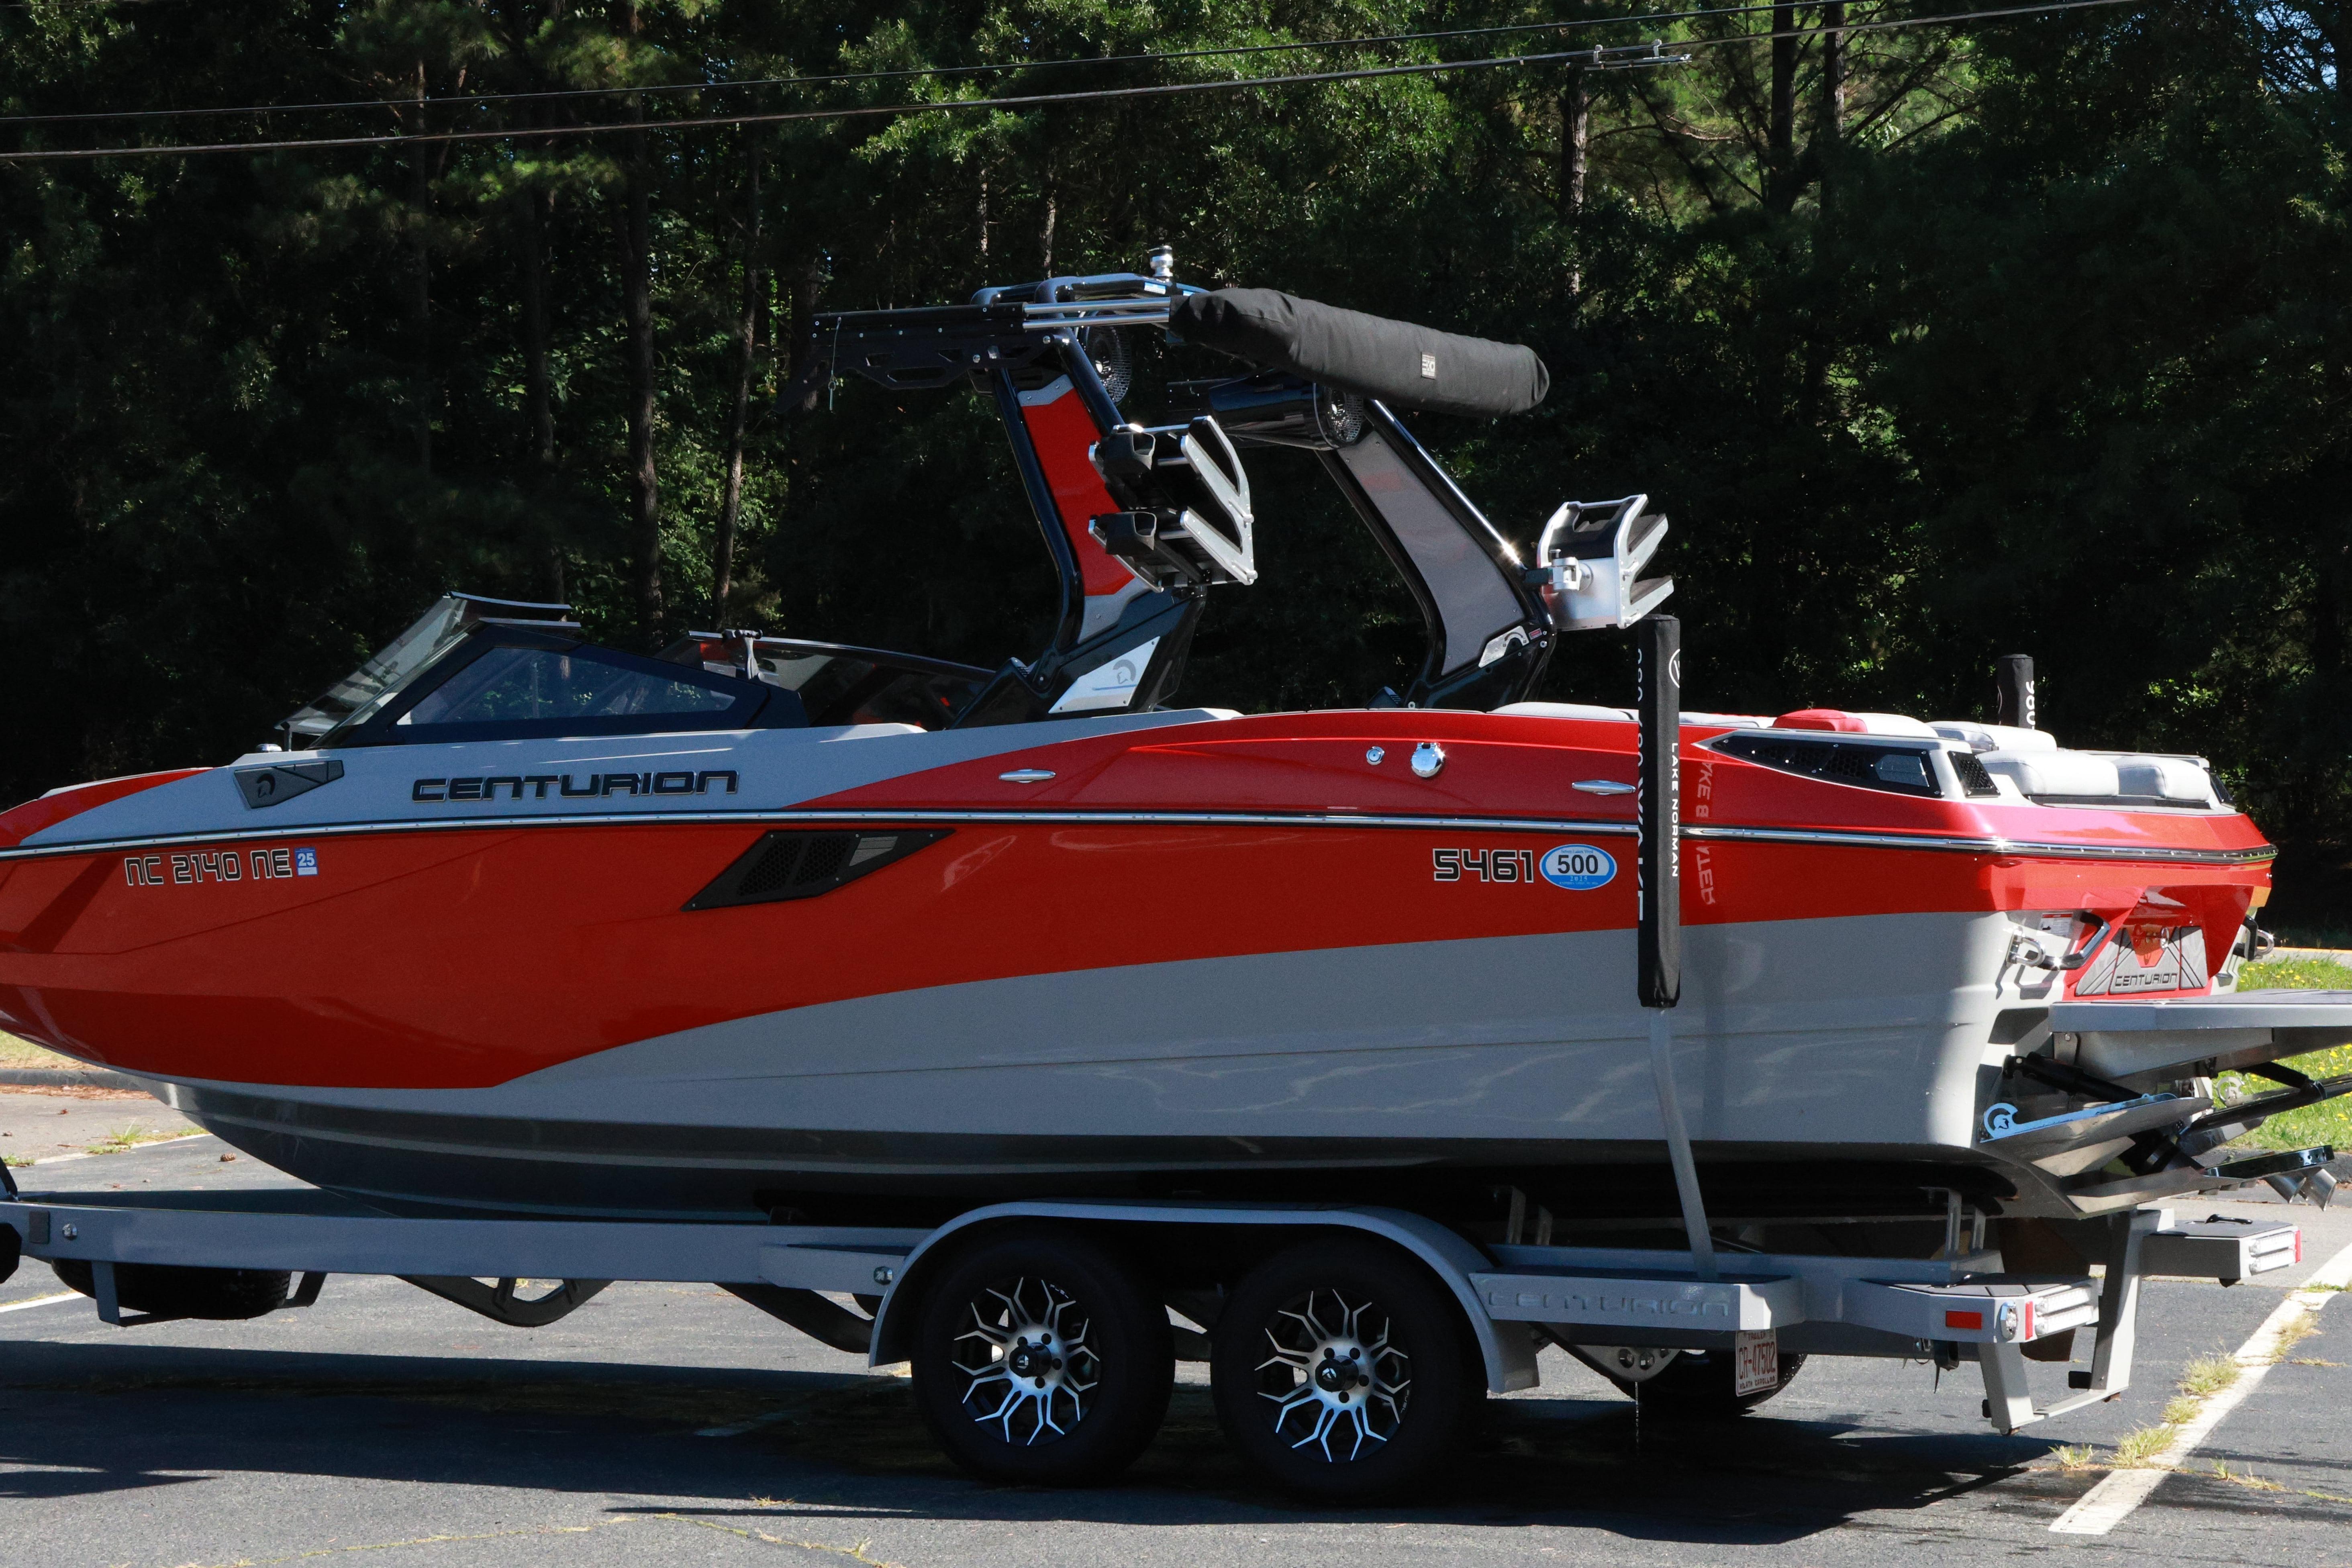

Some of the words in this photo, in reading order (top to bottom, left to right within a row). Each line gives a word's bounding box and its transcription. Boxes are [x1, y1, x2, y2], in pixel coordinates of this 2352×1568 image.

[412, 770, 739, 802] CENTURION
[125, 857, 163, 886] NC
[171, 851, 241, 884] 2140
[250, 848, 292, 880] NE
[297, 852, 315, 867] 25
[1433, 848, 1534, 883] 5461
[1557, 854, 1598, 874] 500
[2115, 973, 2177, 987] CENTURION
[1488, 1292, 1728, 1316] CENTURION
